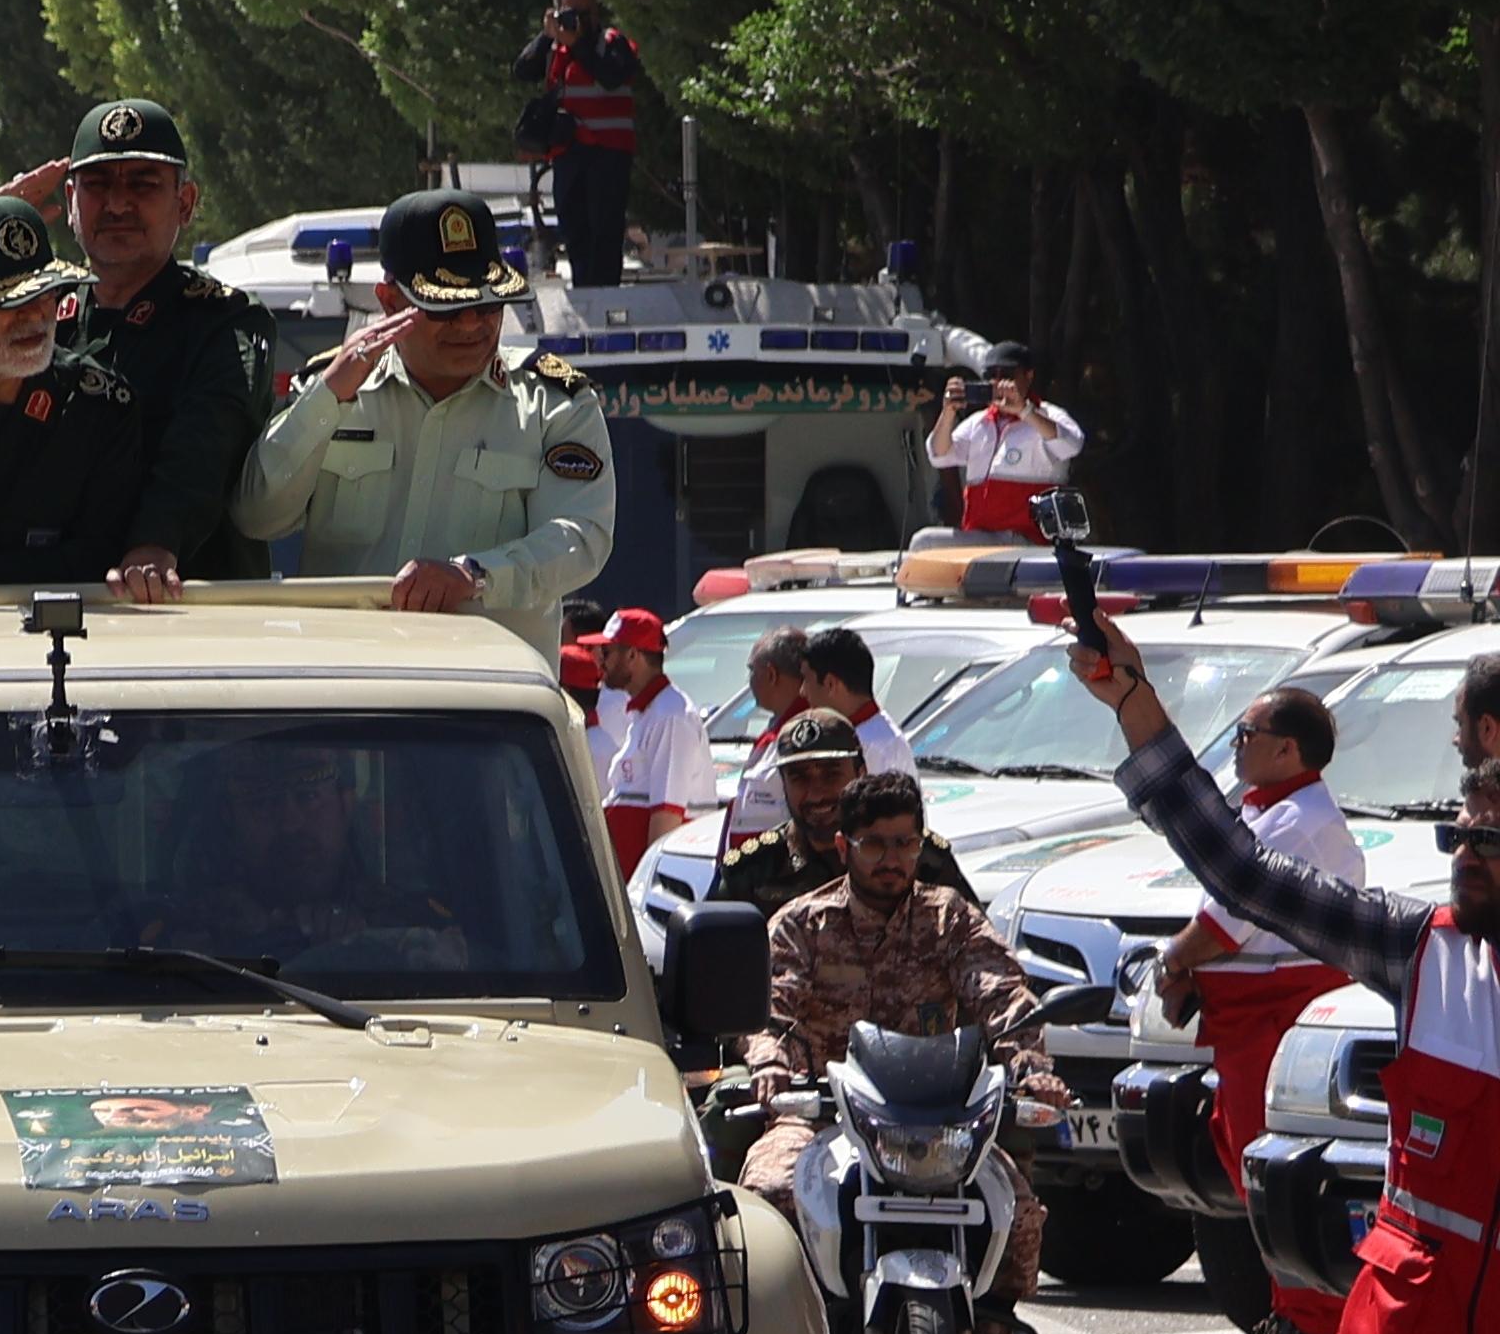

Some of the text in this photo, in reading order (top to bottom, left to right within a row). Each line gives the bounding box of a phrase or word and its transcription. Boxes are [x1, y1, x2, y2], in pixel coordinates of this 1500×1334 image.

[643, 377, 730, 412] عملیات
[729, 373, 855, 411] فرماندهی
[168, 1149, 235, 1166] اسرائیل
[46, 1197, 211, 1222] ARAS
